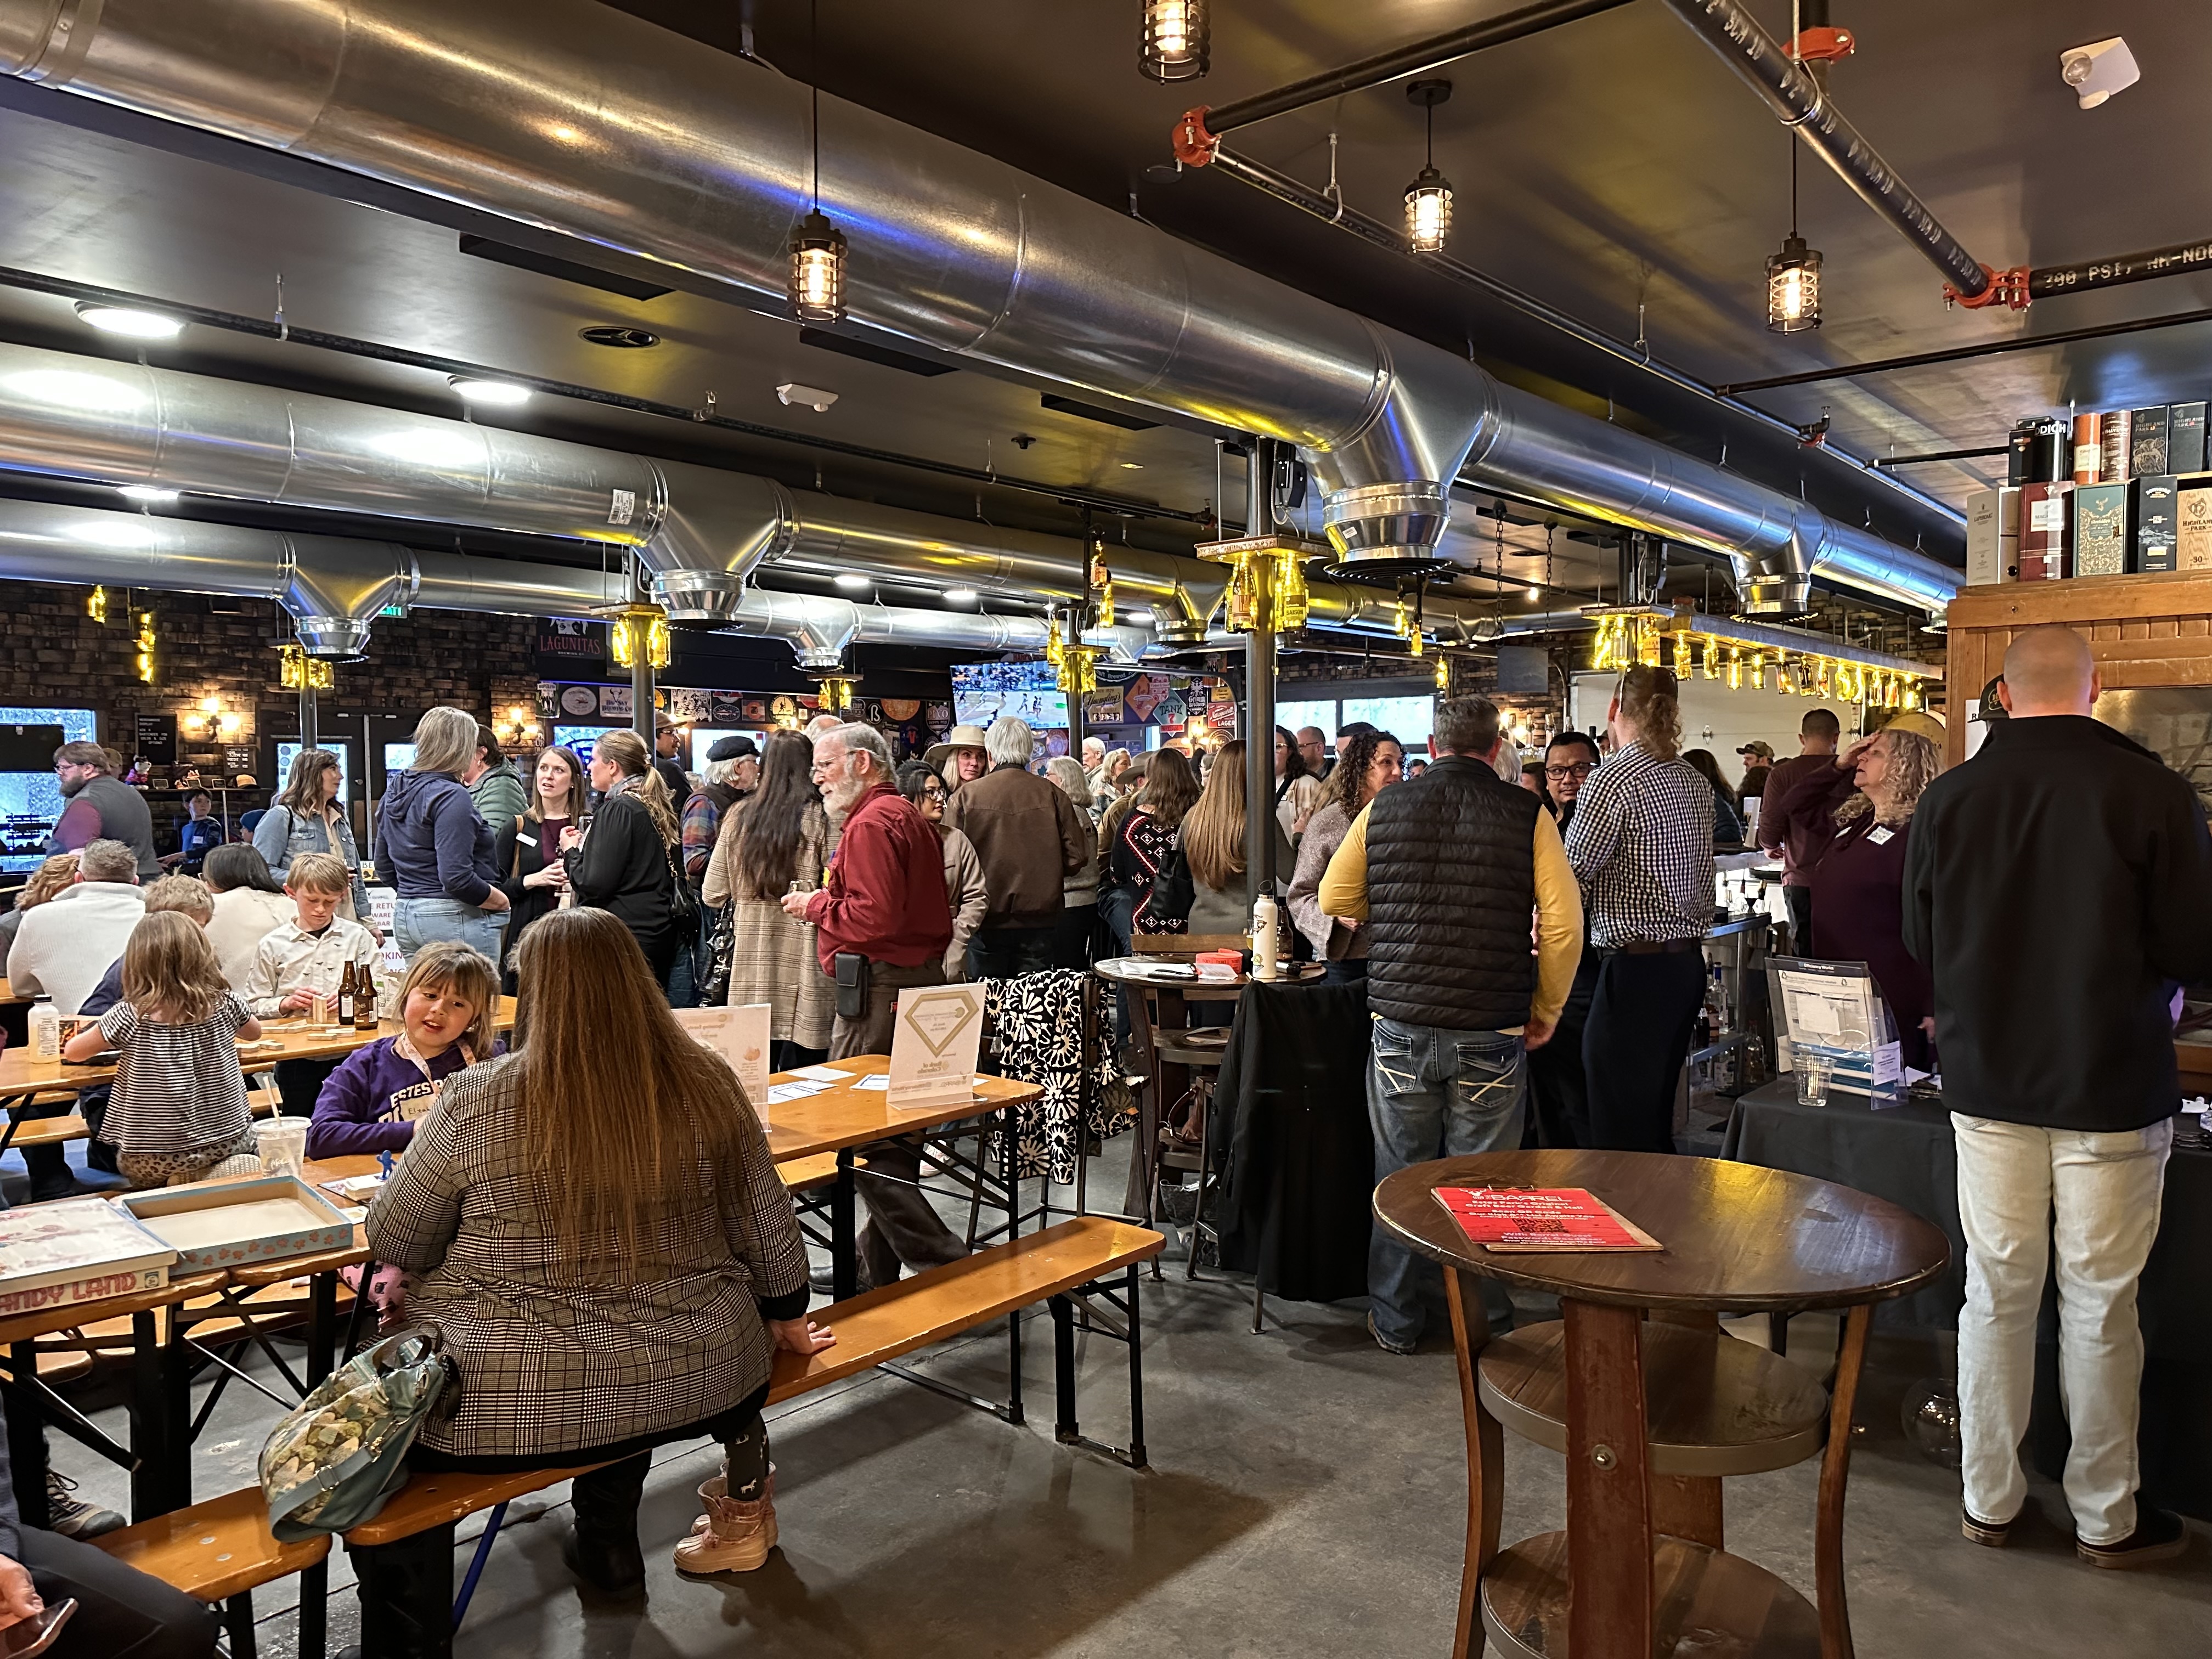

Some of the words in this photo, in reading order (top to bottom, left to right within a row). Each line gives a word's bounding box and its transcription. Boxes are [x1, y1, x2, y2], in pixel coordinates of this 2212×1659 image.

[2089, 262, 2131, 281] PSI,
[540, 635, 601, 654] LAGUNITAS
[927, 709, 949, 719] PIVO
[1159, 704, 1183, 716] TANK
[1168, 714, 1175, 724] 7
[390, 1082, 431, 1108] ESTES
[72, 1272, 137, 1301] LAND
